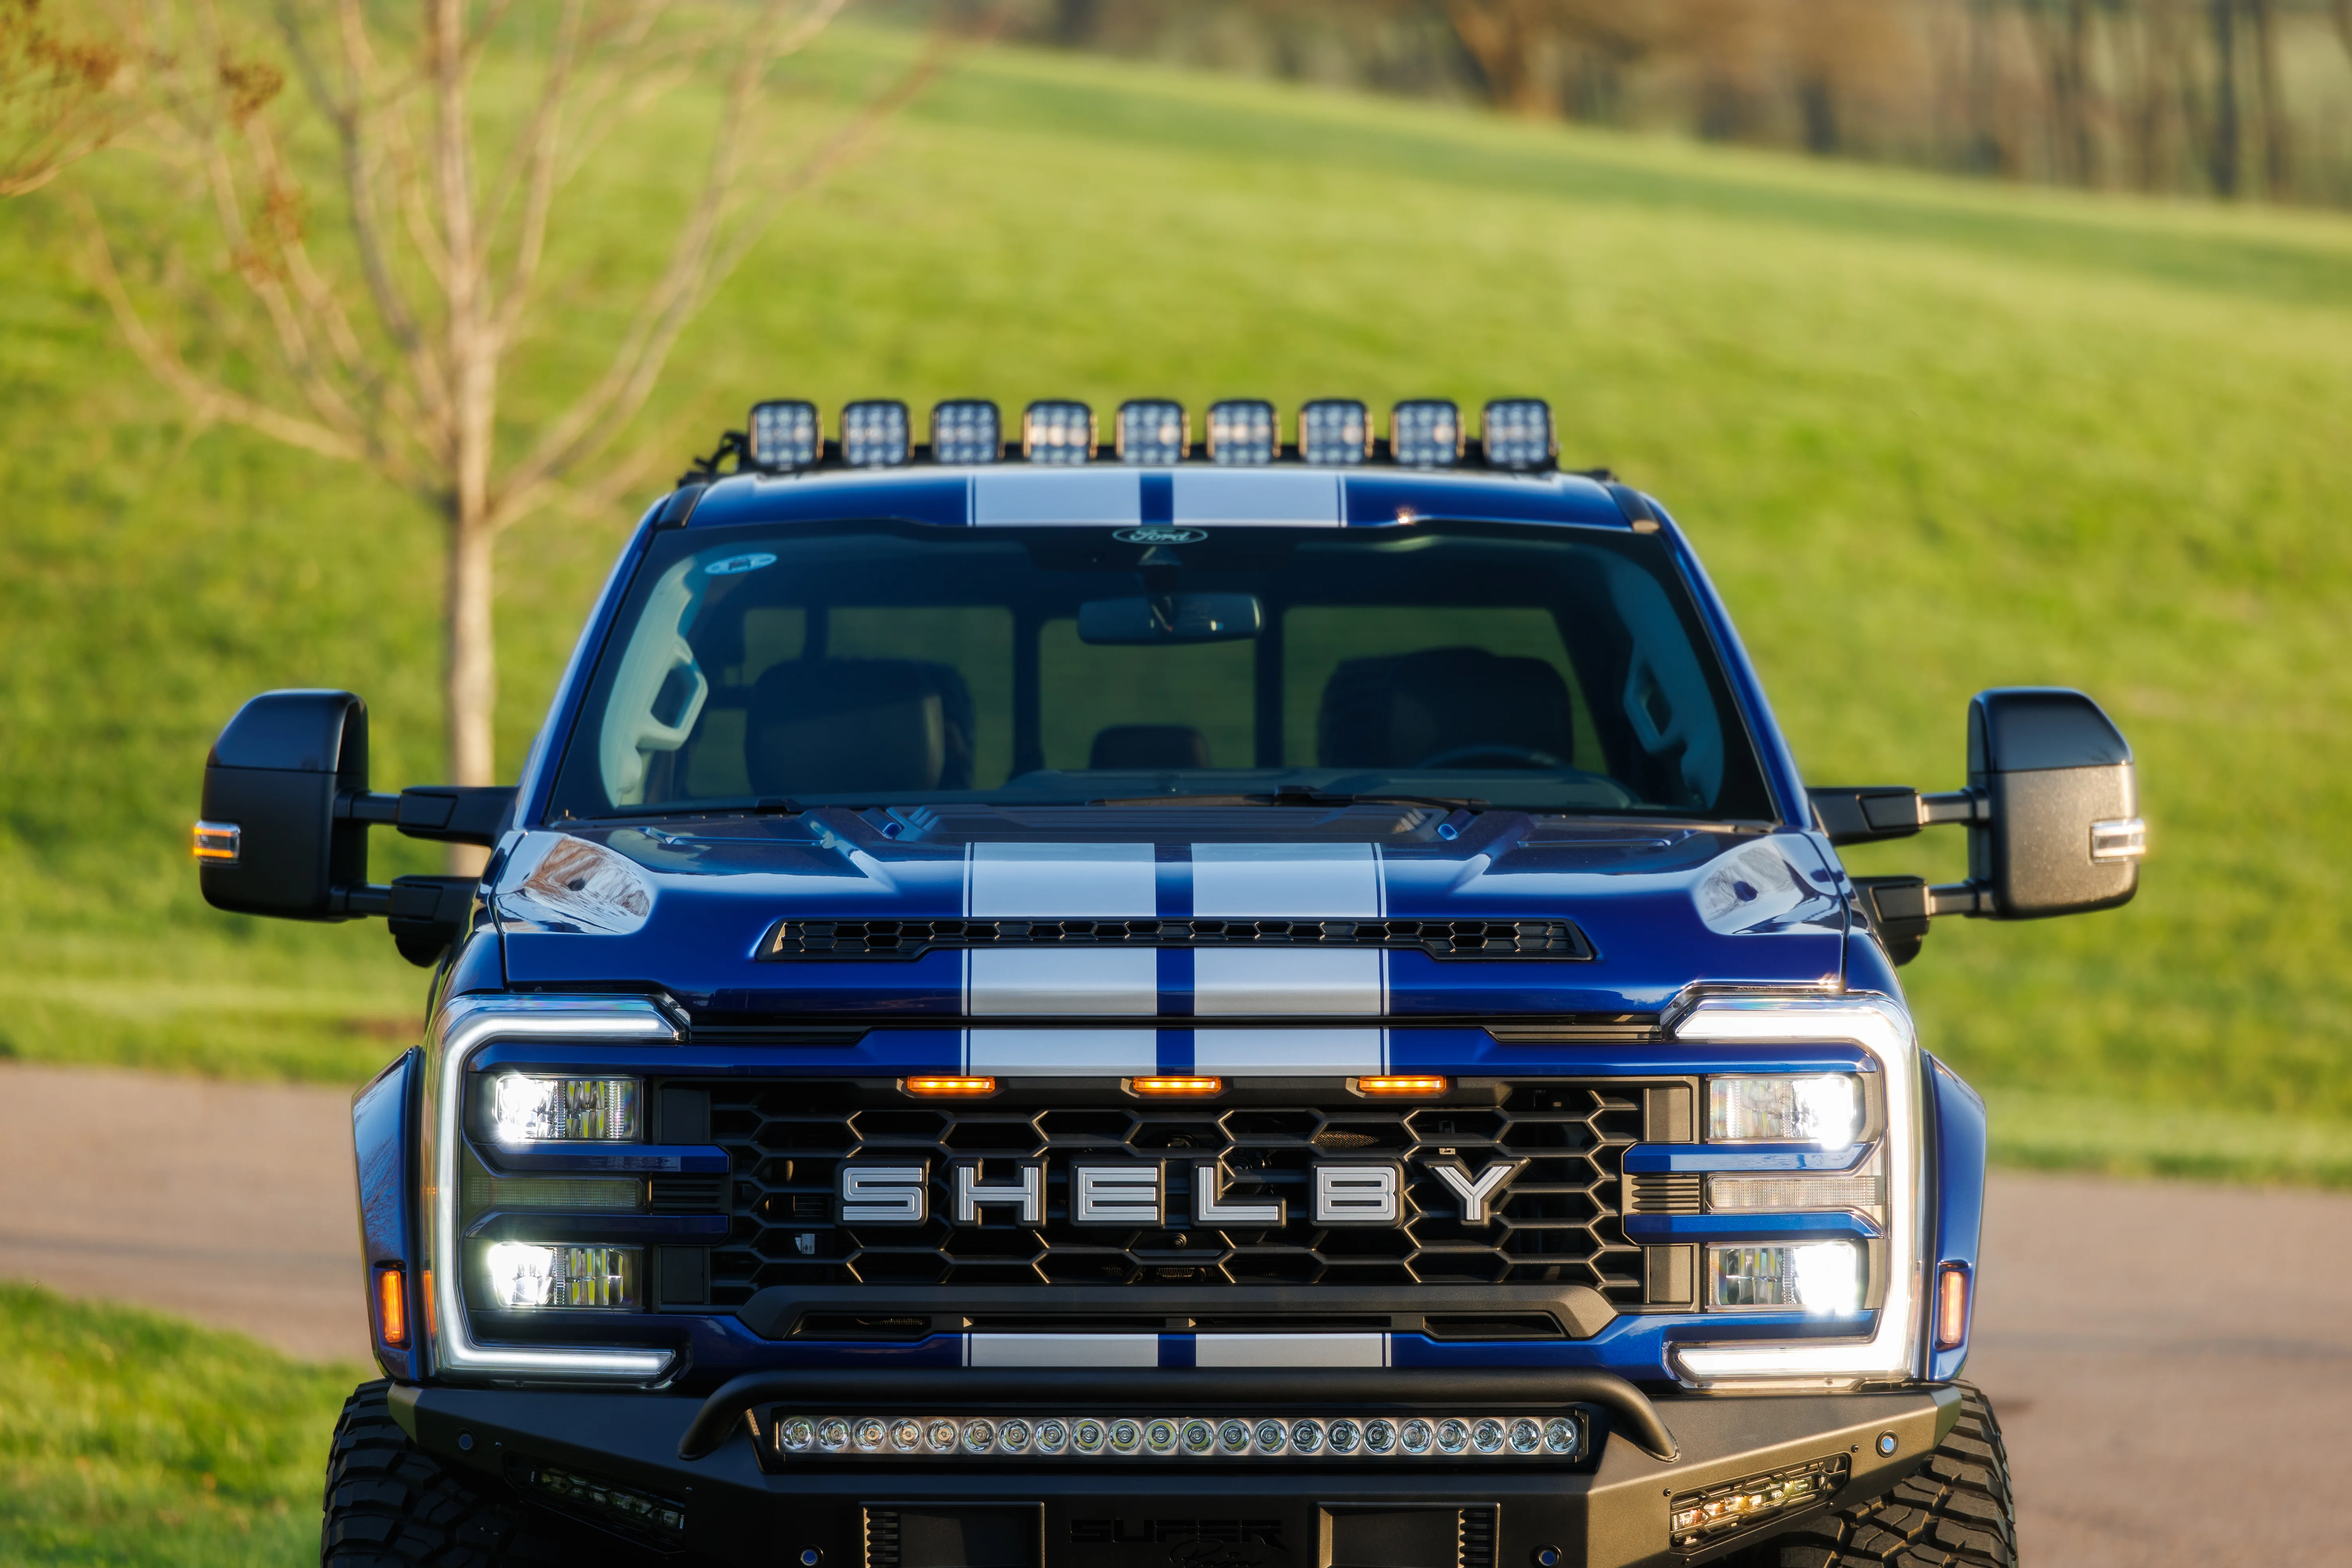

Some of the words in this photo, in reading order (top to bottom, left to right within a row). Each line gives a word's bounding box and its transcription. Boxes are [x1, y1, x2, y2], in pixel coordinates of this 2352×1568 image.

[1130, 530, 1190, 541] Ford
[842, 1166, 1512, 1222] SHELBY
[1071, 1519, 1289, 1552] SUPER
